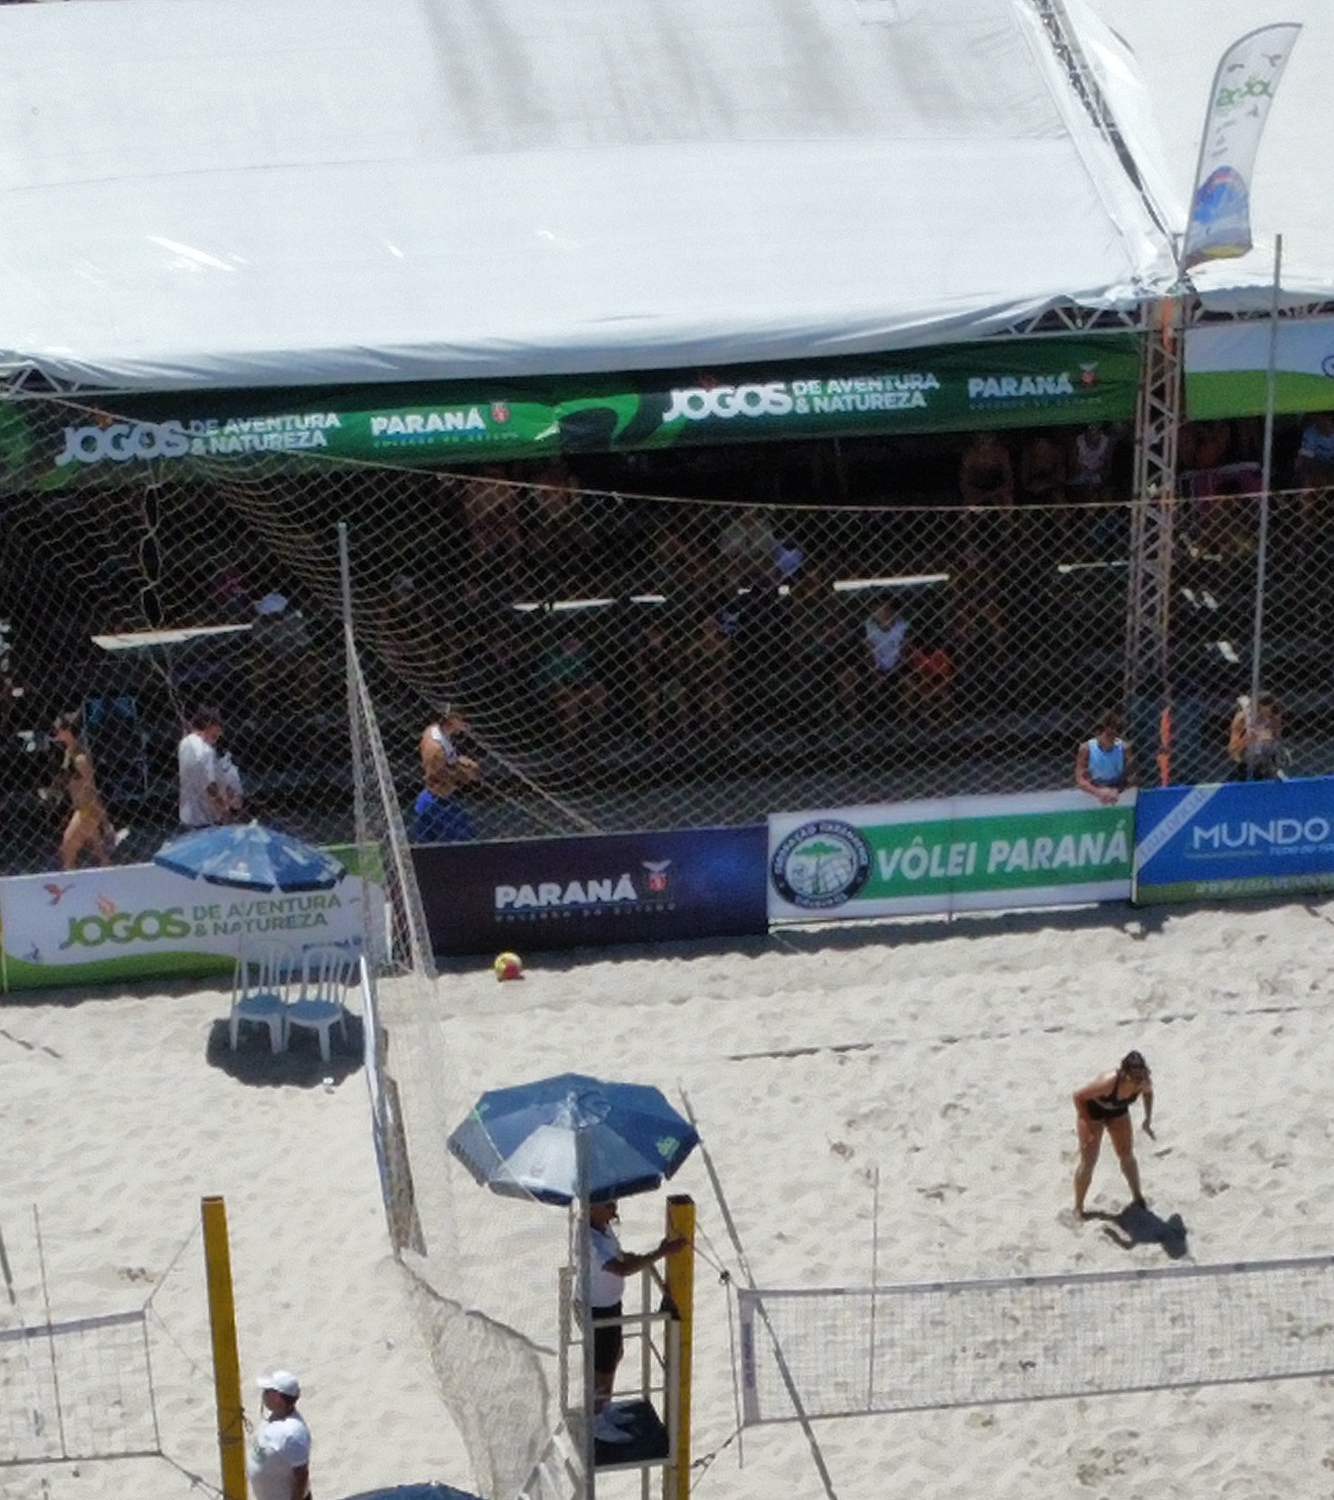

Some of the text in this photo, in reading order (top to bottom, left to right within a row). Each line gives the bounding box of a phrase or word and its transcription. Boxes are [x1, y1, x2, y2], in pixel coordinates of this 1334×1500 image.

[793, 372, 941, 396] DE AVENTURA
[968, 371, 1074, 399] PARANÁ
[662, 382, 793, 423] JOGOS
[794, 390, 928, 415] & NATUREZA
[190, 411, 342, 436] DE AVENTURA
[370, 407, 487, 436] PARANÁ
[54, 419, 190, 468] JOGOS
[190, 429, 328, 455] & NATUREZA
[1192, 817, 1330, 850] MUNDO
[877, 835, 978, 882] VÔLEI
[986, 819, 1130, 874] PARANÁ
[494, 873, 639, 910] PARANÁ
[193, 893, 342, 921] DE AVENTURA
[58, 906, 193, 951] JOGOS
[192, 912, 328, 938] & NATUREZA
